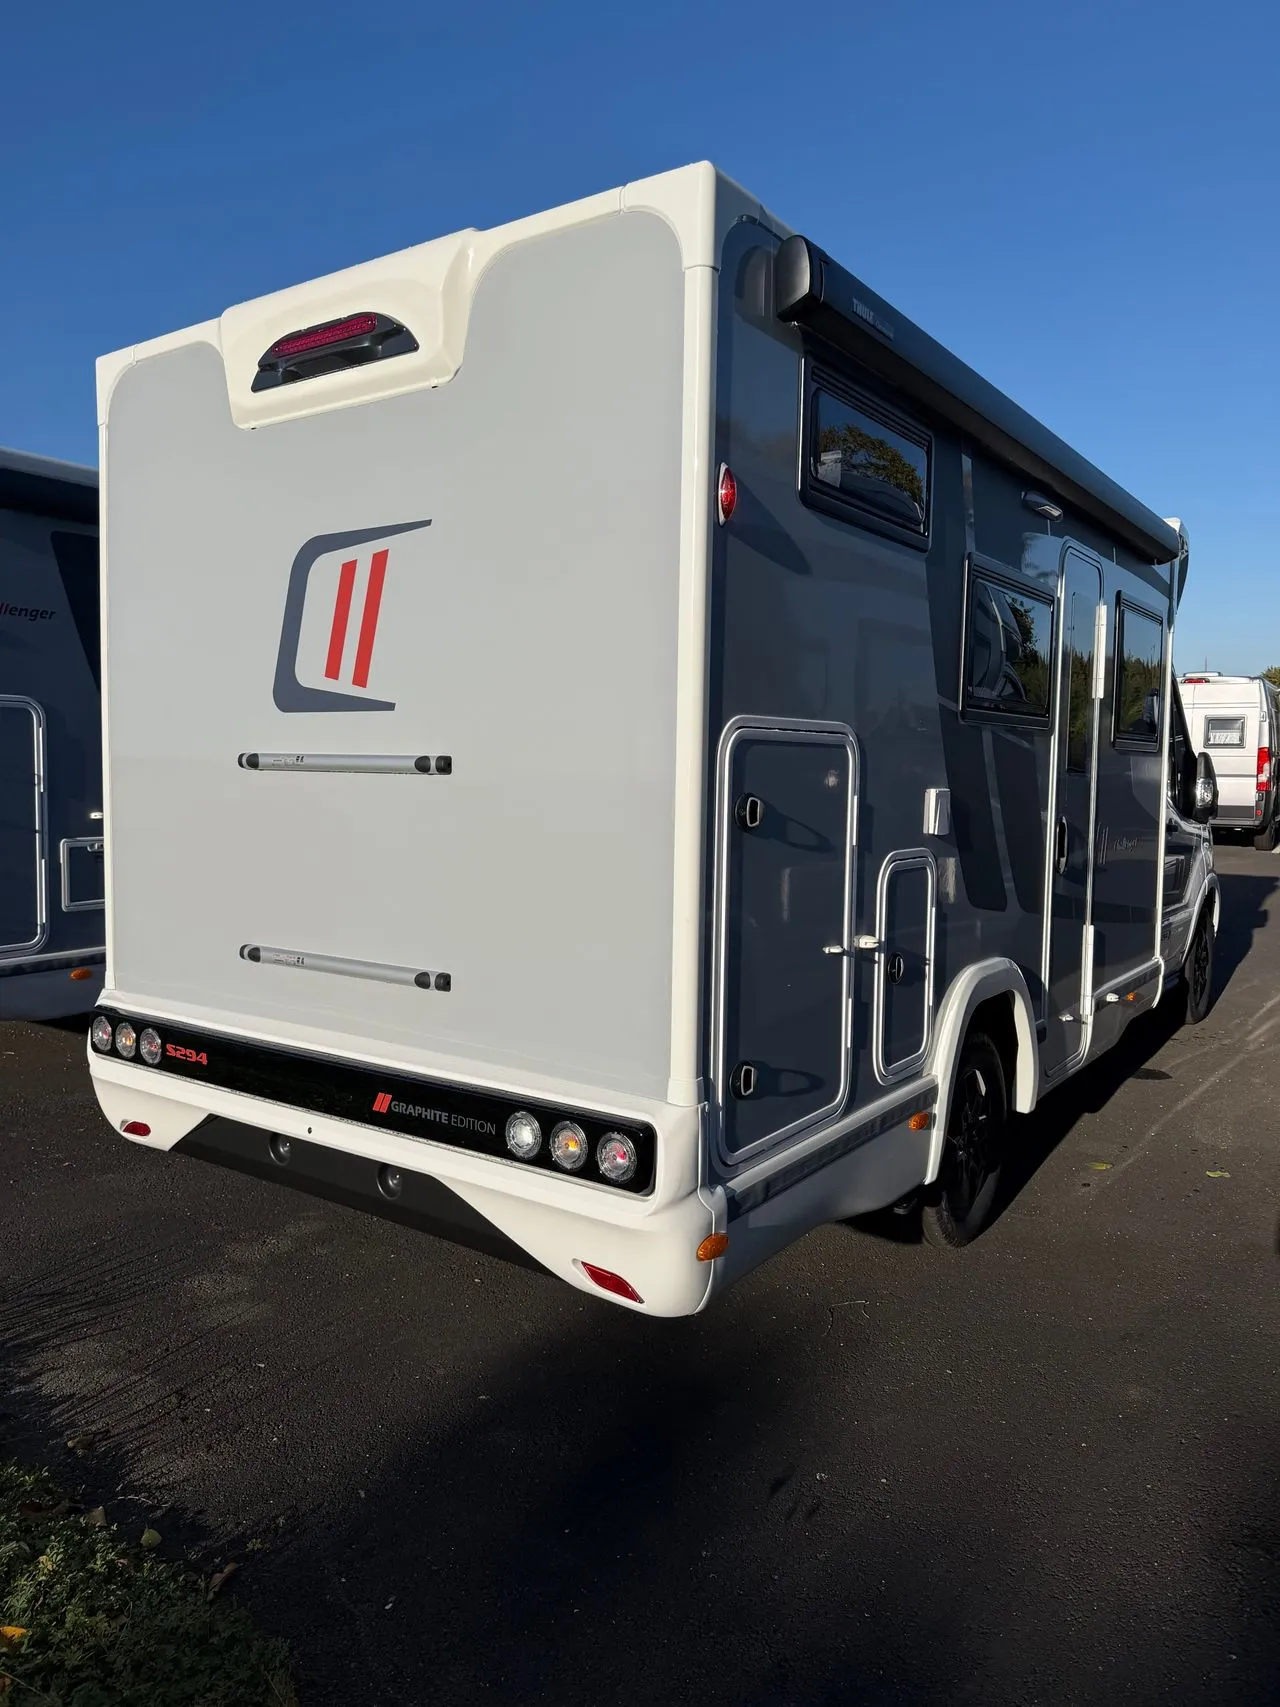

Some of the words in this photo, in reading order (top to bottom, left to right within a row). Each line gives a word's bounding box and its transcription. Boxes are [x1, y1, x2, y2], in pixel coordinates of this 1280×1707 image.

[166, 1043, 208, 1065] S294
[391, 1101, 449, 1124] GRAPHITE
[451, 1114, 496, 1135] EDITION
